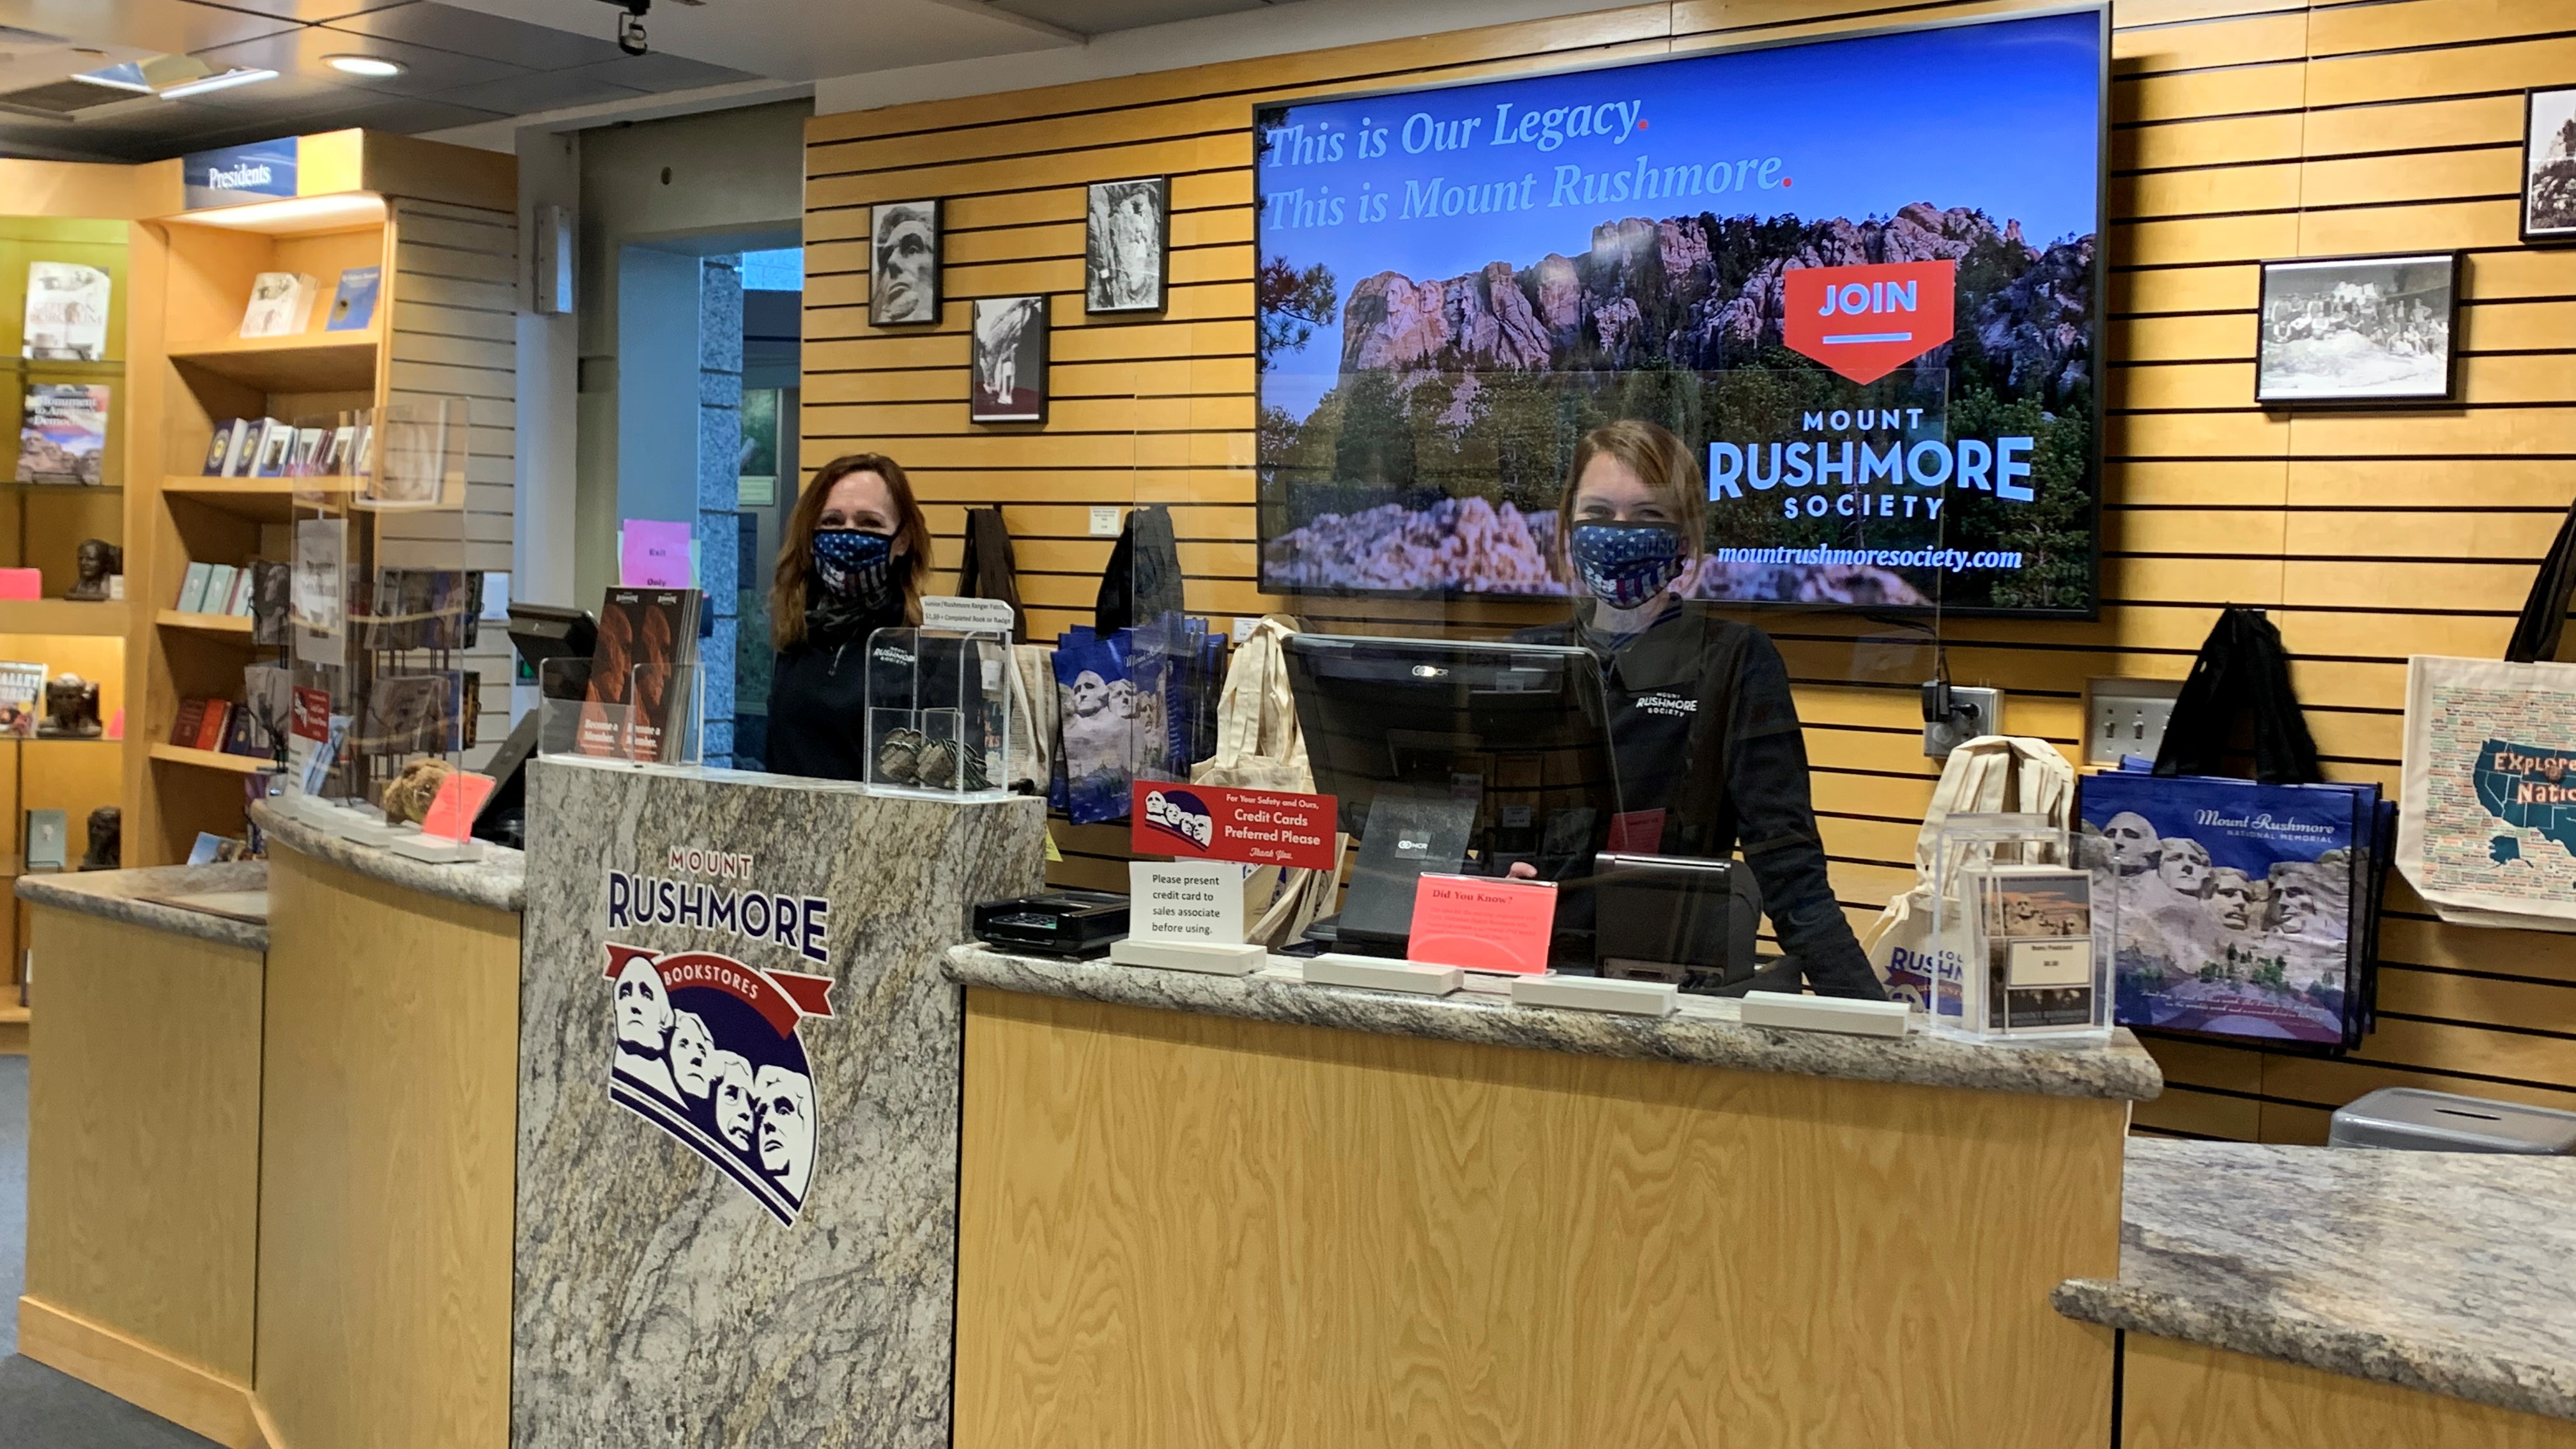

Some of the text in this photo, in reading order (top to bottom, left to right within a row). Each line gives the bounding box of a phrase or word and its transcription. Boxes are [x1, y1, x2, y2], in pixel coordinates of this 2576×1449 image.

[1266, 100, 1648, 167] This is Our Legacy.
[209, 163, 272, 190] Presidents
[1268, 155, 1792, 231] This is Mount Rushmore.
[1818, 280, 1917, 316] JOIN
[1802, 408, 1924, 432] MOUNT
[1708, 436, 2035, 502] RUSHMORE
[1784, 494, 1945, 520] SOCIETY
[649, 548, 666, 556] Exit
[1717, 544, 2023, 572] mountrushmoresociety.com
[647, 578, 666, 587] Only
[1636, 696, 1698, 712] RUSHMORE
[1648, 707, 1685, 717] SOCIETY
[1226, 793, 1238, 802] For
[1239, 795, 1256, 804] Your
[1257, 796, 1280, 807] Safety
[1298, 800, 1319, 810] Ours,
[1234, 808, 1308, 826] Credit Cards
[2194, 809, 2335, 834] Mount Rushmore
[1225, 825, 1321, 845] Preferred Please
[2227, 830, 2333, 843] NATIONAL MEMORIAL
[1250, 847, 1273, 857] Thank
[670, 848, 752, 878] MOUNT
[1153, 874, 1220, 886] Please present
[1153, 891, 1214, 901] credit card to
[1432, 889, 1513, 904] Did You Know?
[610, 871, 829, 963] RUSHMORE
[1153, 906, 1220, 917] sales associate
[1152, 922, 1213, 935] before using.
[664, 965, 758, 999] BOOKSTORES
